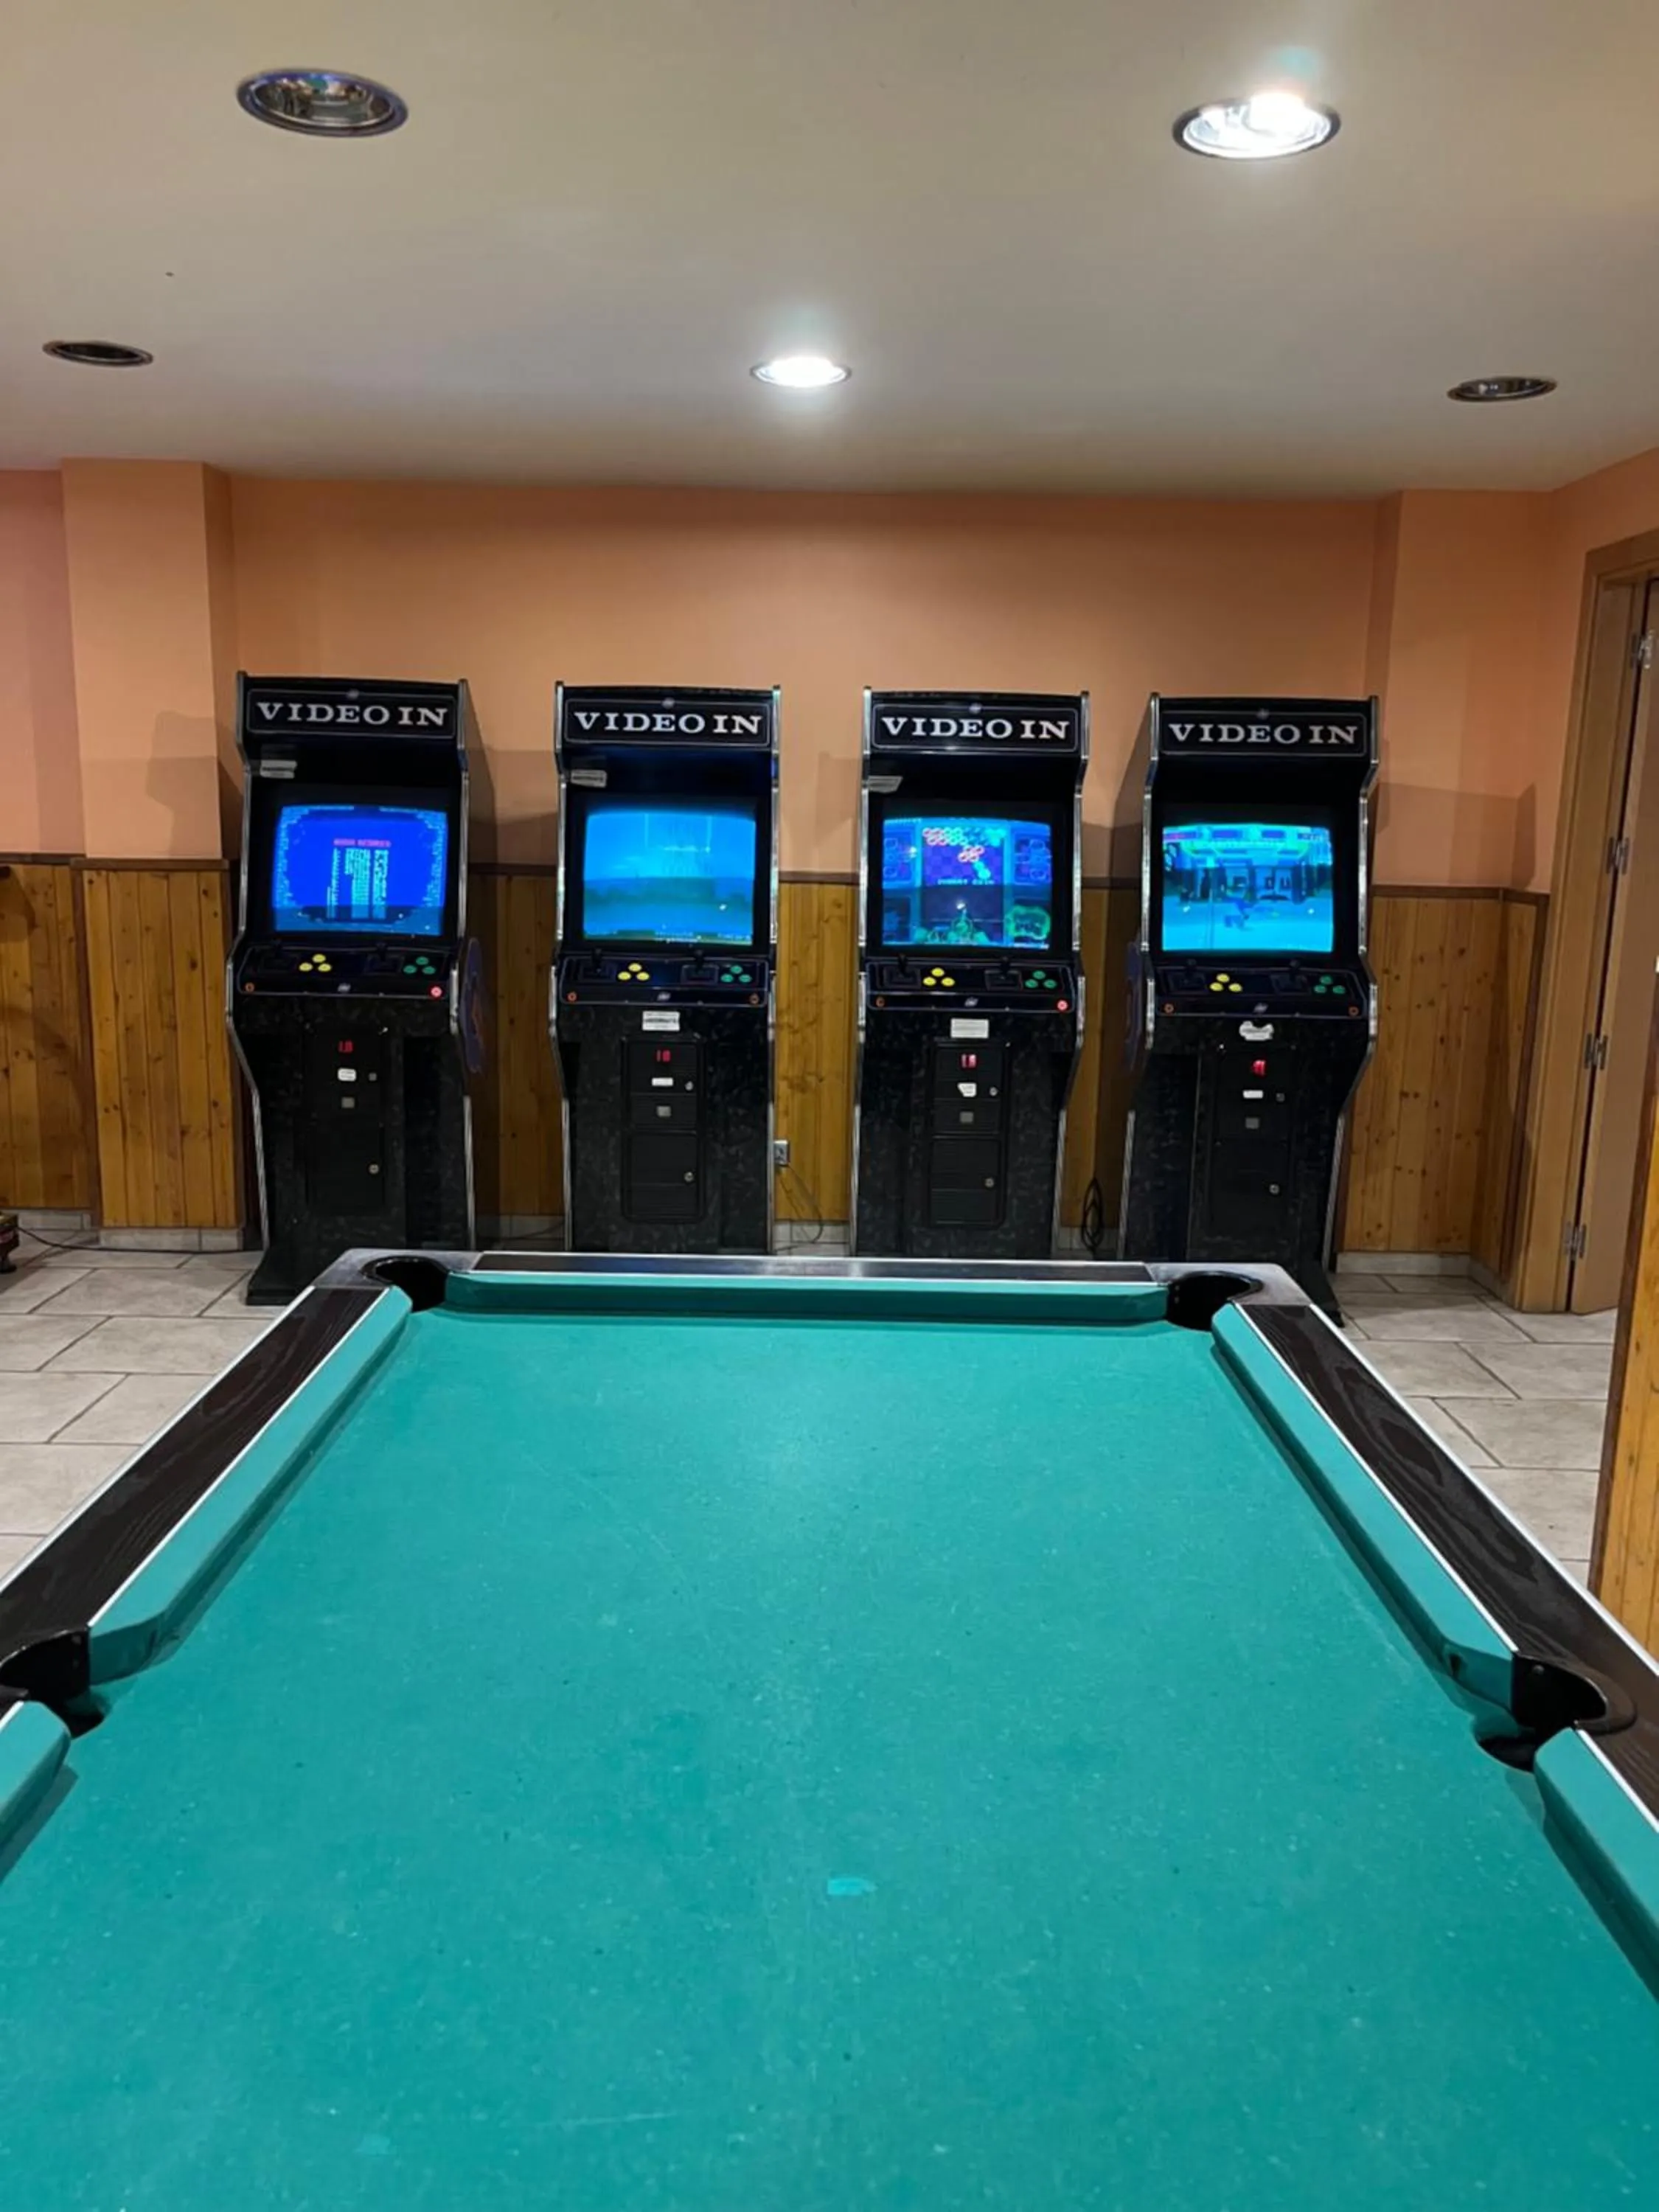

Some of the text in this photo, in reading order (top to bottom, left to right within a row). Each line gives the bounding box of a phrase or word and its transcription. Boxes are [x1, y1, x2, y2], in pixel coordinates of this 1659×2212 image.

[257, 702, 448, 726] VIDEO IN
[574, 712, 762, 734] VIDEO IN
[881, 717, 1070, 740] VIDEO IN
[1168, 723, 1358, 745] VIDEO IN
